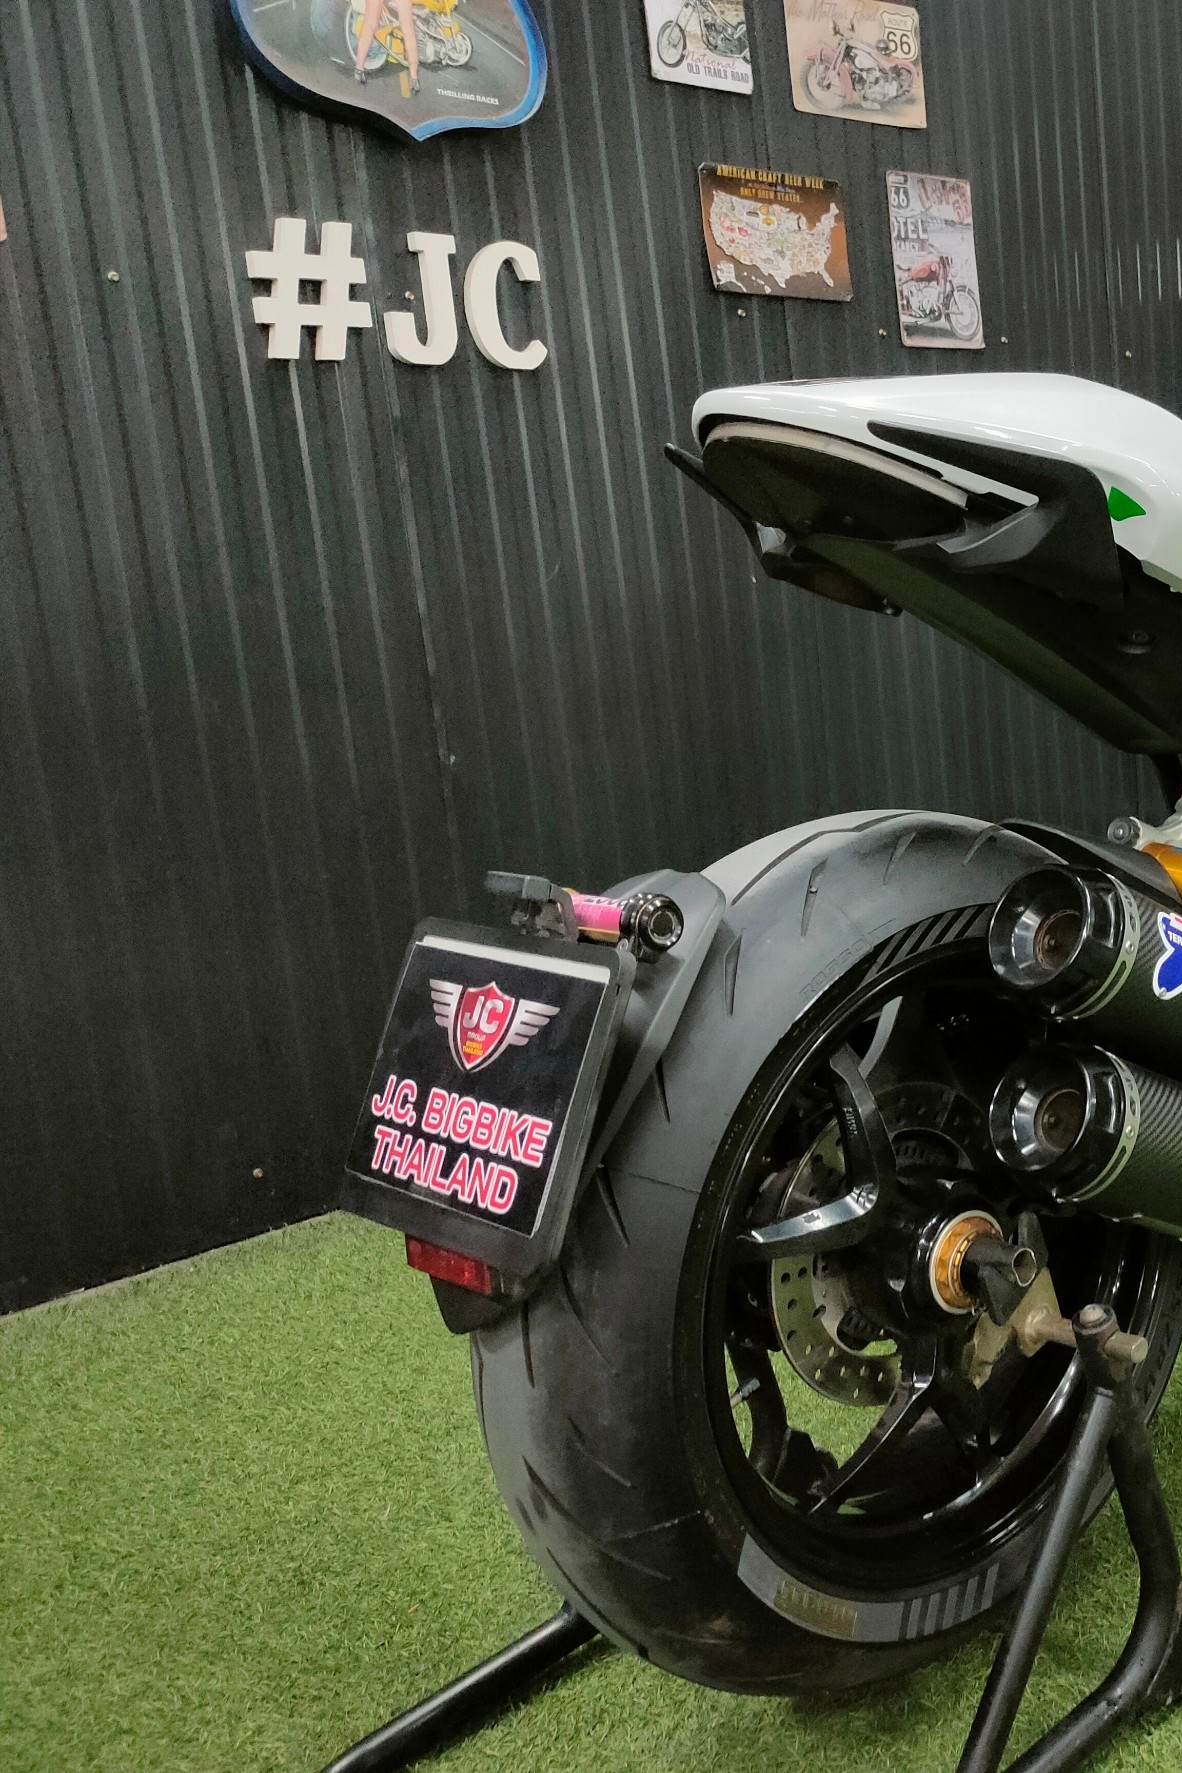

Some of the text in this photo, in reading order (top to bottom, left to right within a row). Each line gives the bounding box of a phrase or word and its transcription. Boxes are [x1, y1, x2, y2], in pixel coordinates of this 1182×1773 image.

[887, 17, 909, 28] ROUTE
[886, 31, 911, 55] 66
[687, 62, 749, 84] OLD TRAILS ROAD
[717, 164, 756, 181] AMERICAN
[890, 187, 908, 208] 66
[245, 217, 548, 370] #JC
[462, 995, 504, 1034] JC
[371, 1074, 553, 1169] J.C. BIGBIKE
[371, 1124, 519, 1215] THAILAND
